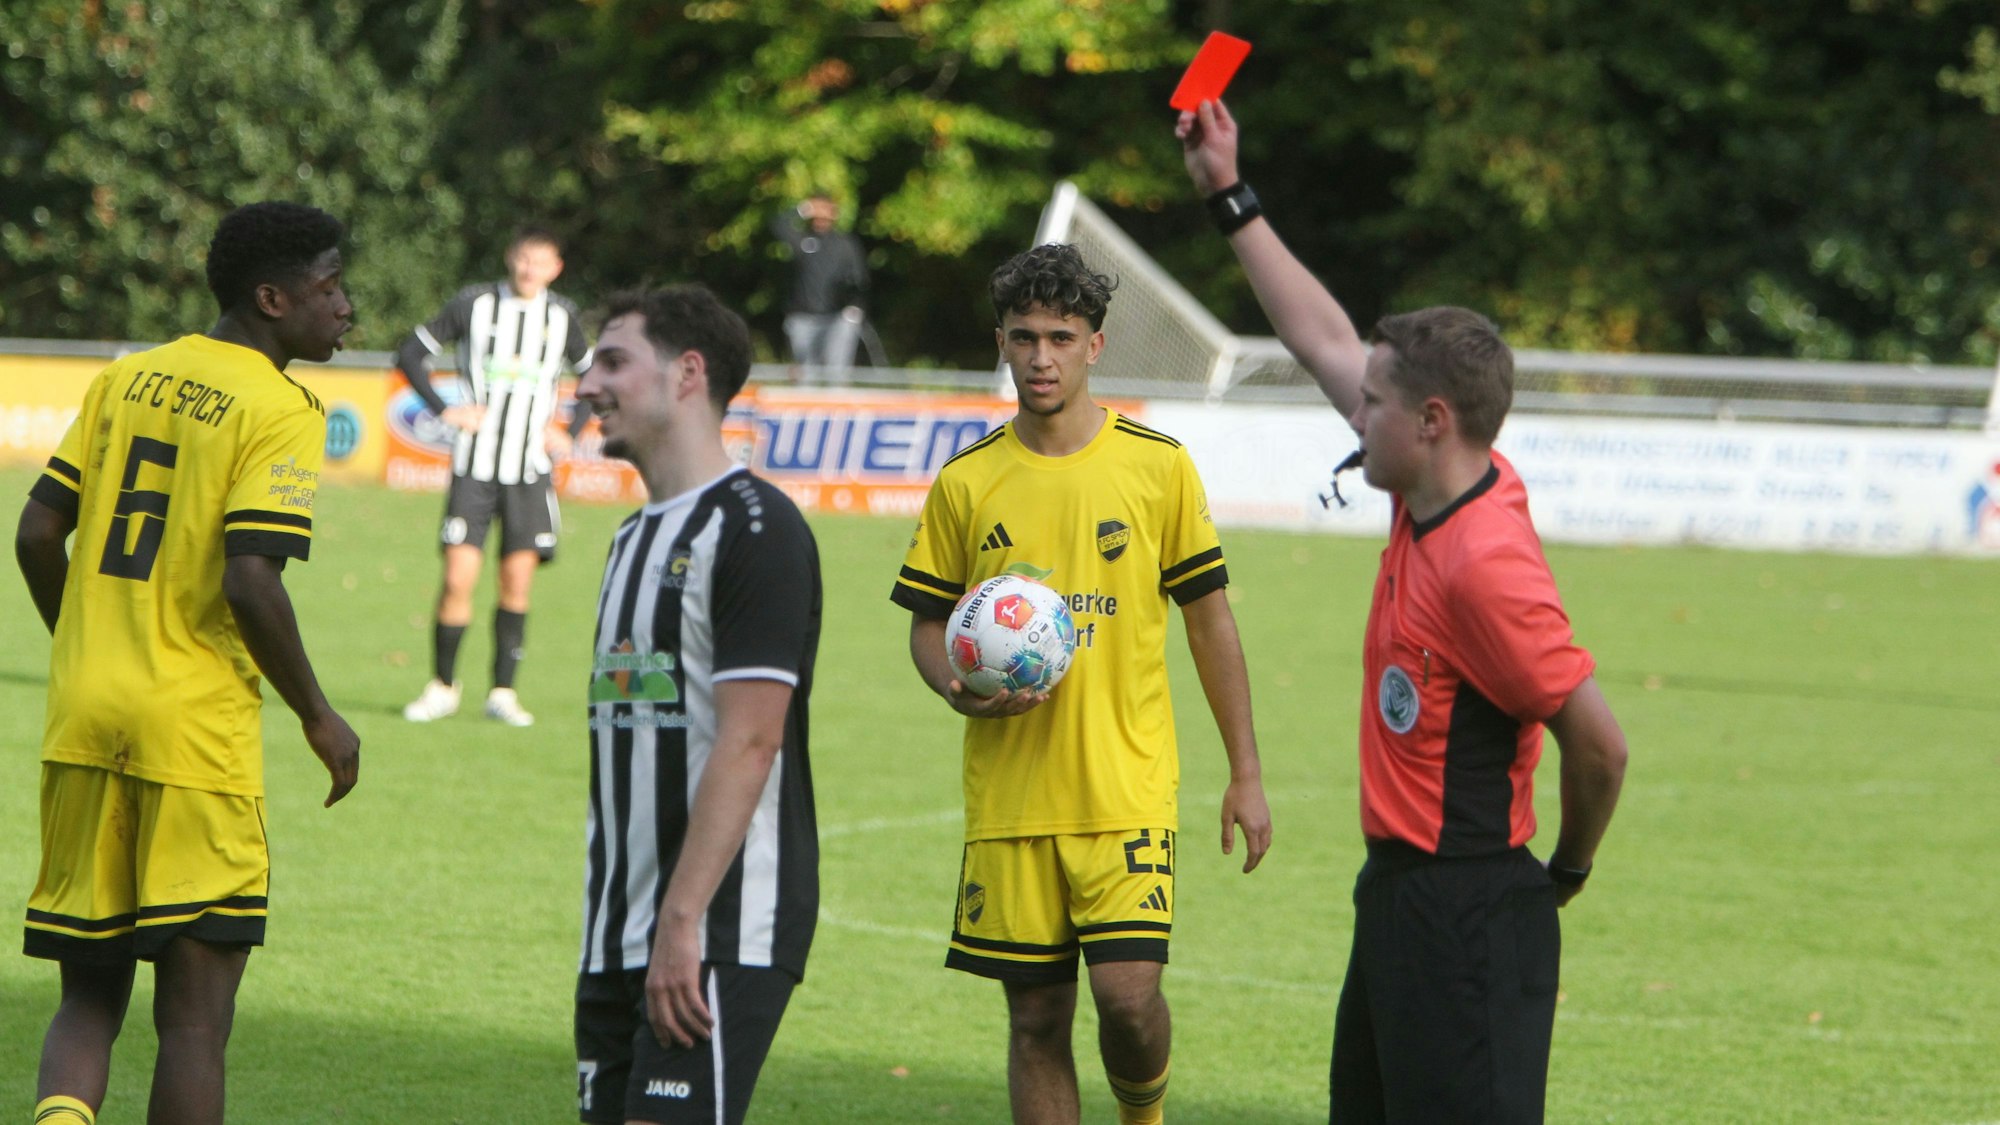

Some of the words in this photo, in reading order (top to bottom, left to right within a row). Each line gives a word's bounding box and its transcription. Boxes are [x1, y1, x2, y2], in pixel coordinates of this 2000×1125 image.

[123, 371, 172, 408] 1.FC
[171, 379, 235, 428] SPICH
[271, 464, 288, 478] RF
[98, 435, 178, 582] 6
[645, 1080, 691, 1098] JAKO
